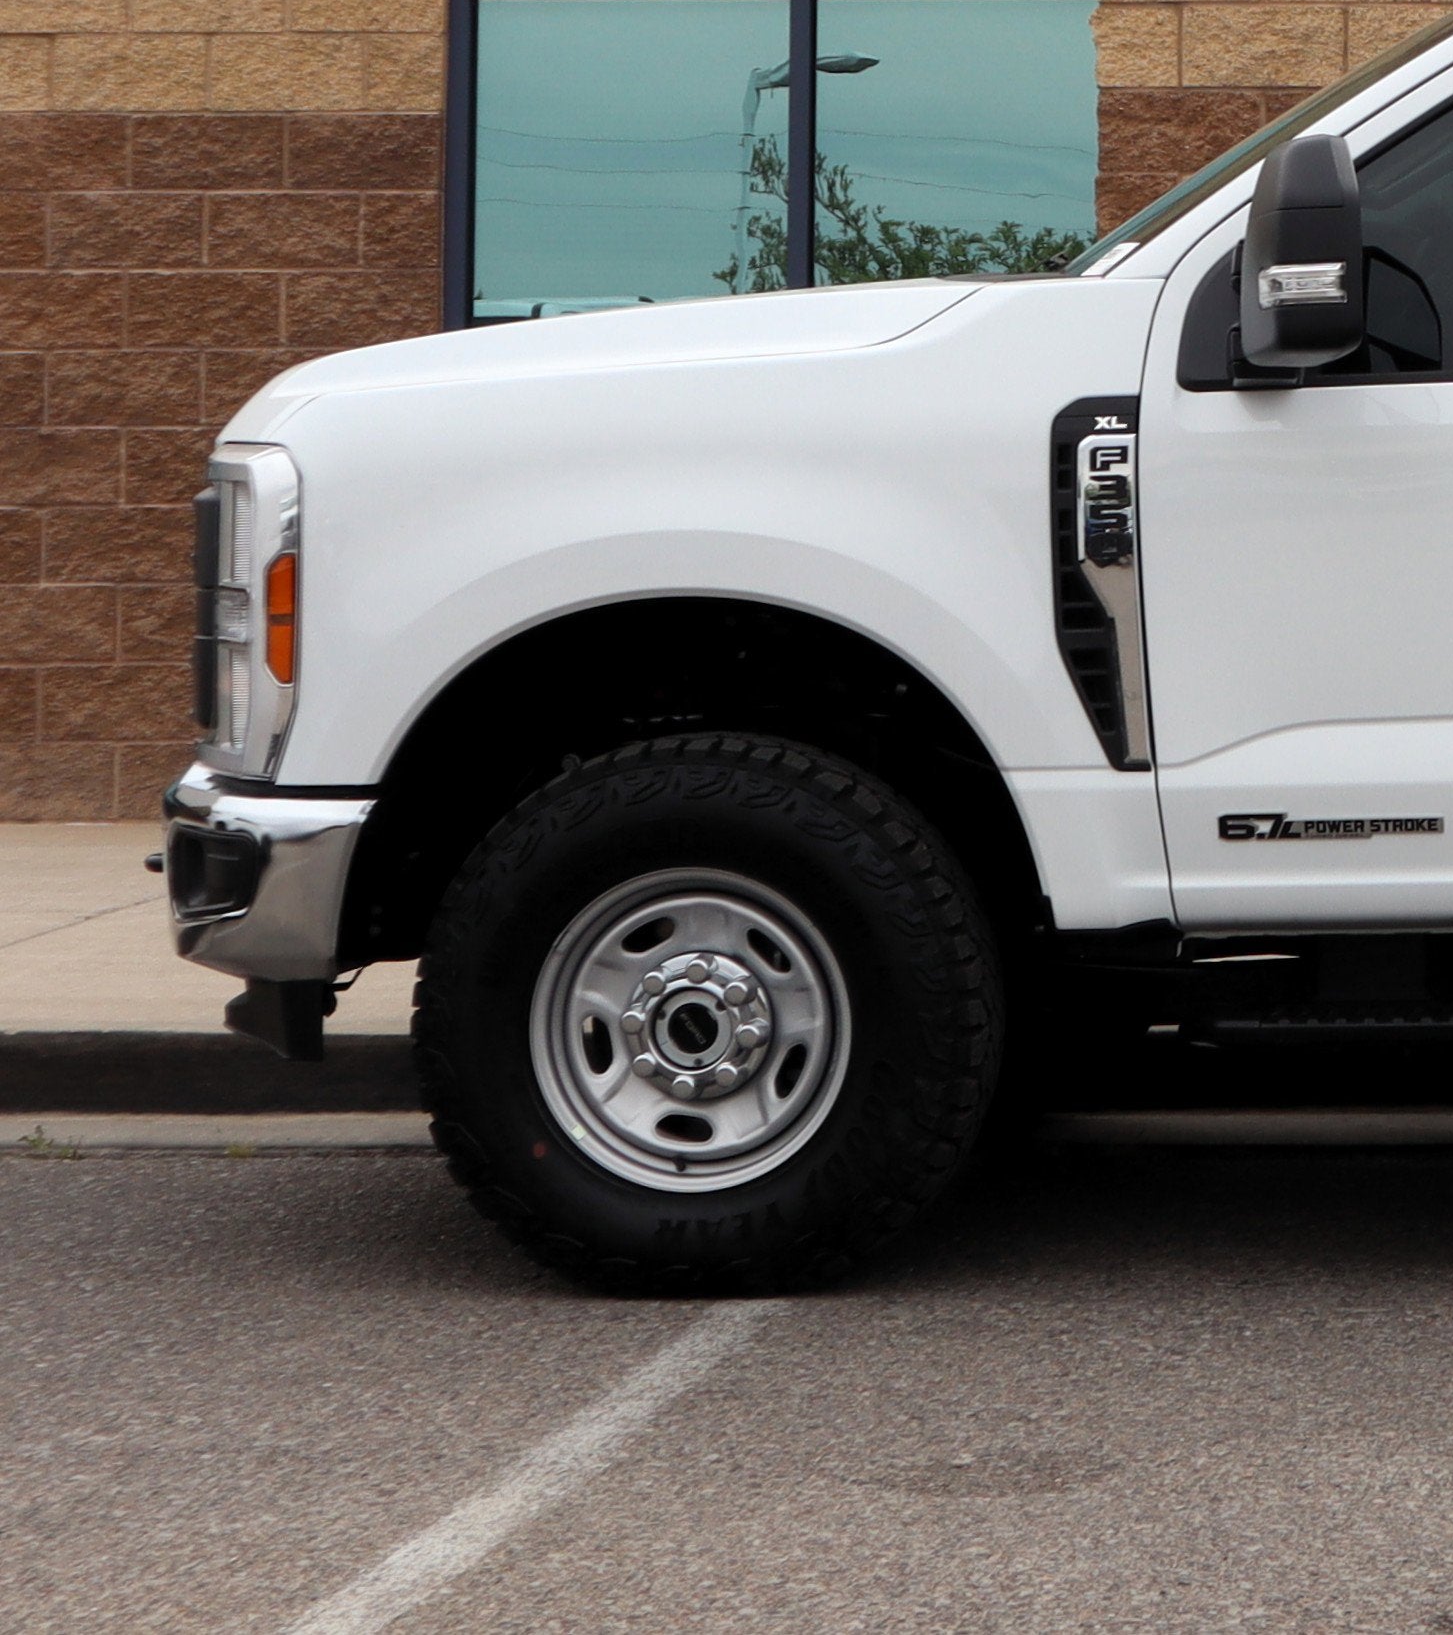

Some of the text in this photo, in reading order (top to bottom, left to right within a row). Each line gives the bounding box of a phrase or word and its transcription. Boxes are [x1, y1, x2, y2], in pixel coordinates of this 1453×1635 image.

[1094, 415, 1129, 431] XL
[1304, 820, 1365, 834] POWER
[1370, 818, 1438, 833] STROKE
